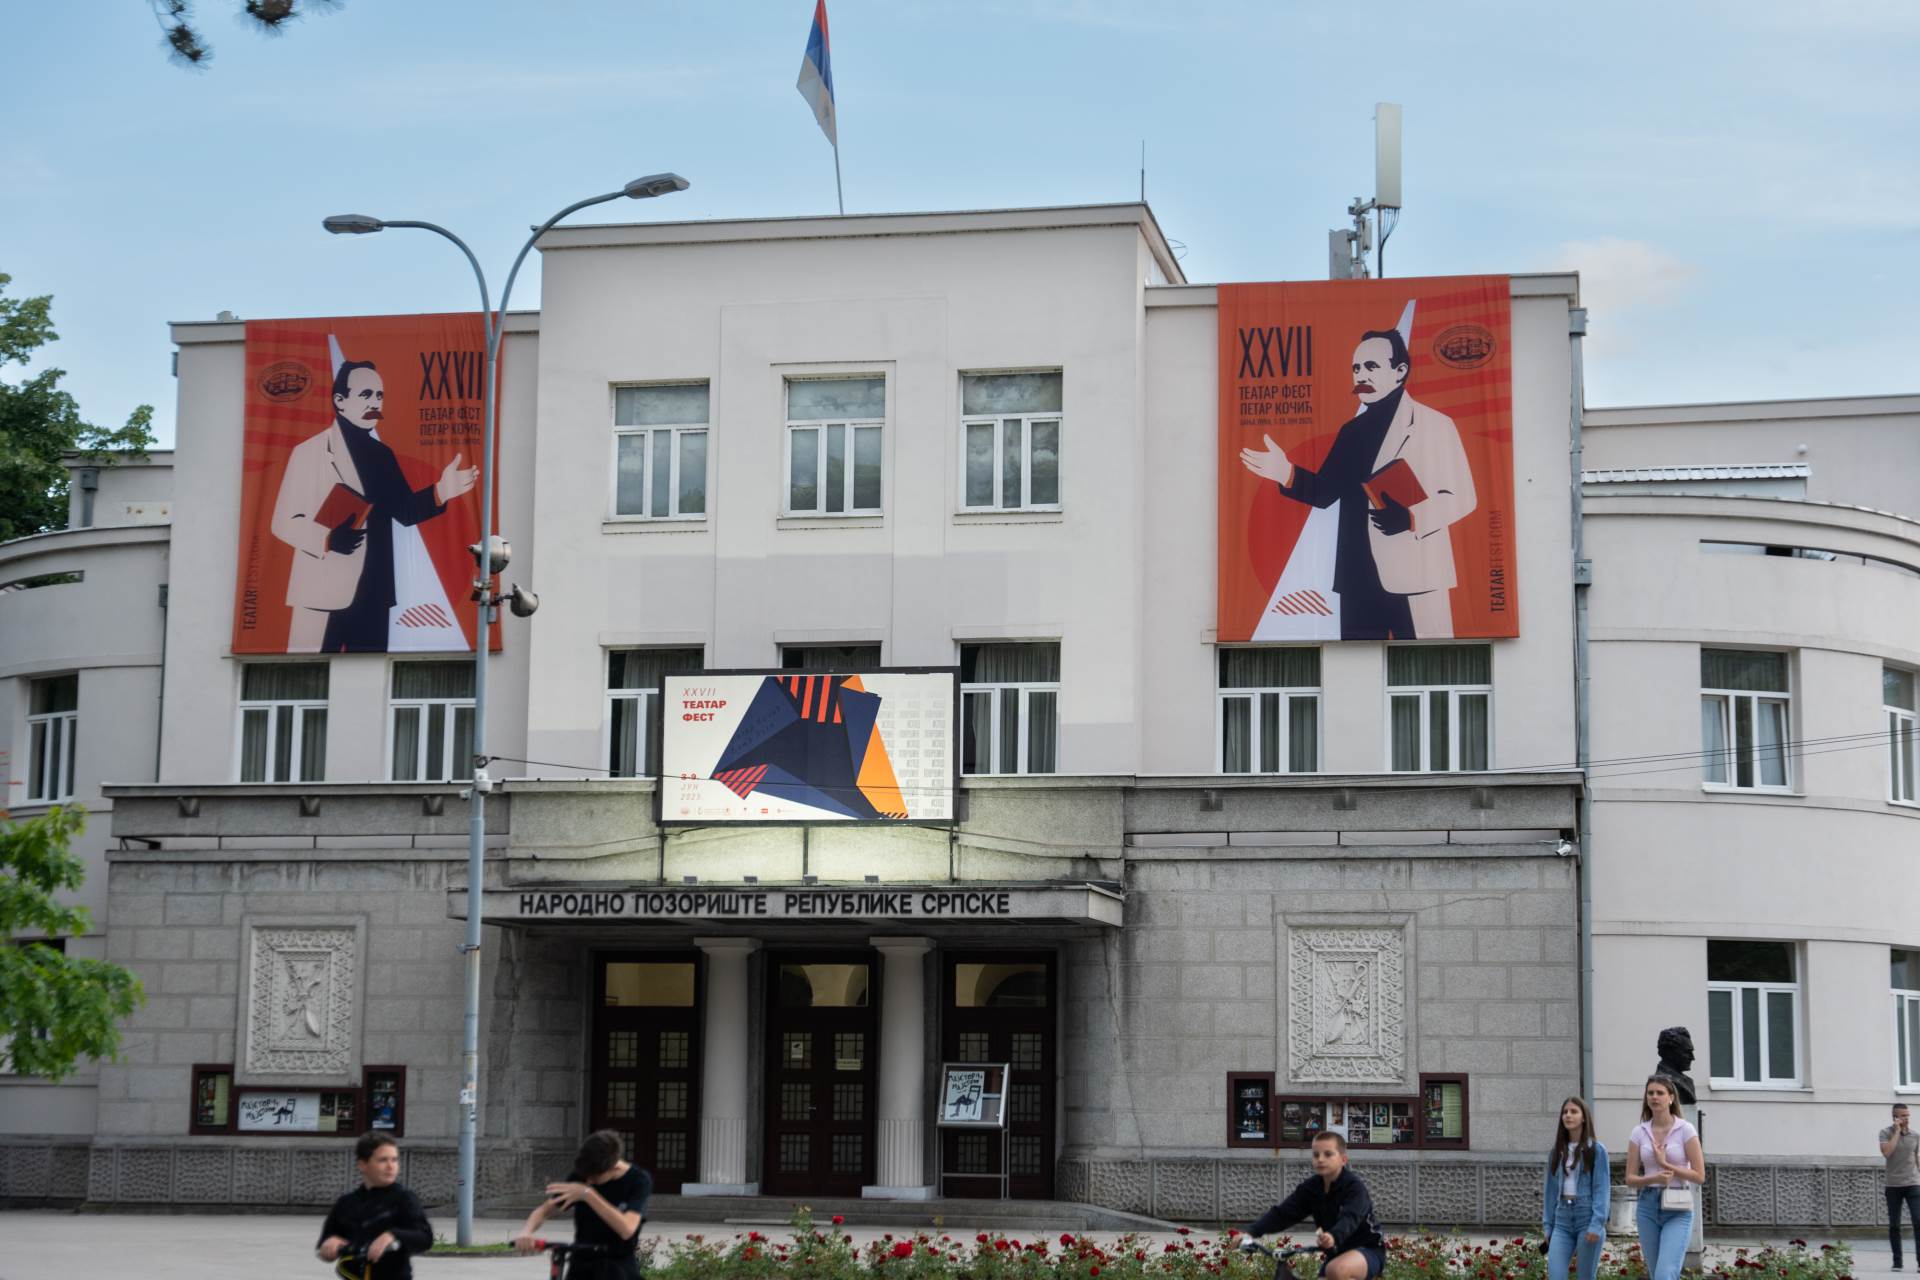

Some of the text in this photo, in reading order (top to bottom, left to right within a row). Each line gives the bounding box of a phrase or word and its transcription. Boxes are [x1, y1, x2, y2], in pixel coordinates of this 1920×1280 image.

[1239, 326, 1311, 378] XXVII
[420, 352, 483, 400] XXVII
[1239, 384, 1312, 400] ТЕАТАР ФЕСТ
[419, 408, 454, 420] ТЕАТАР
[1240, 401, 1312, 416] ПЕТАР КОЧИЋ
[683, 688, 716, 696] XXVII
[683, 700, 727, 709] ТЕАТАР
[683, 713, 715, 721] ФЕСТ
[520, 893, 1010, 916] НАРОДНО ПОЗОРИШТЕ РЕПУБЛИКЕ СРПСКЕ
